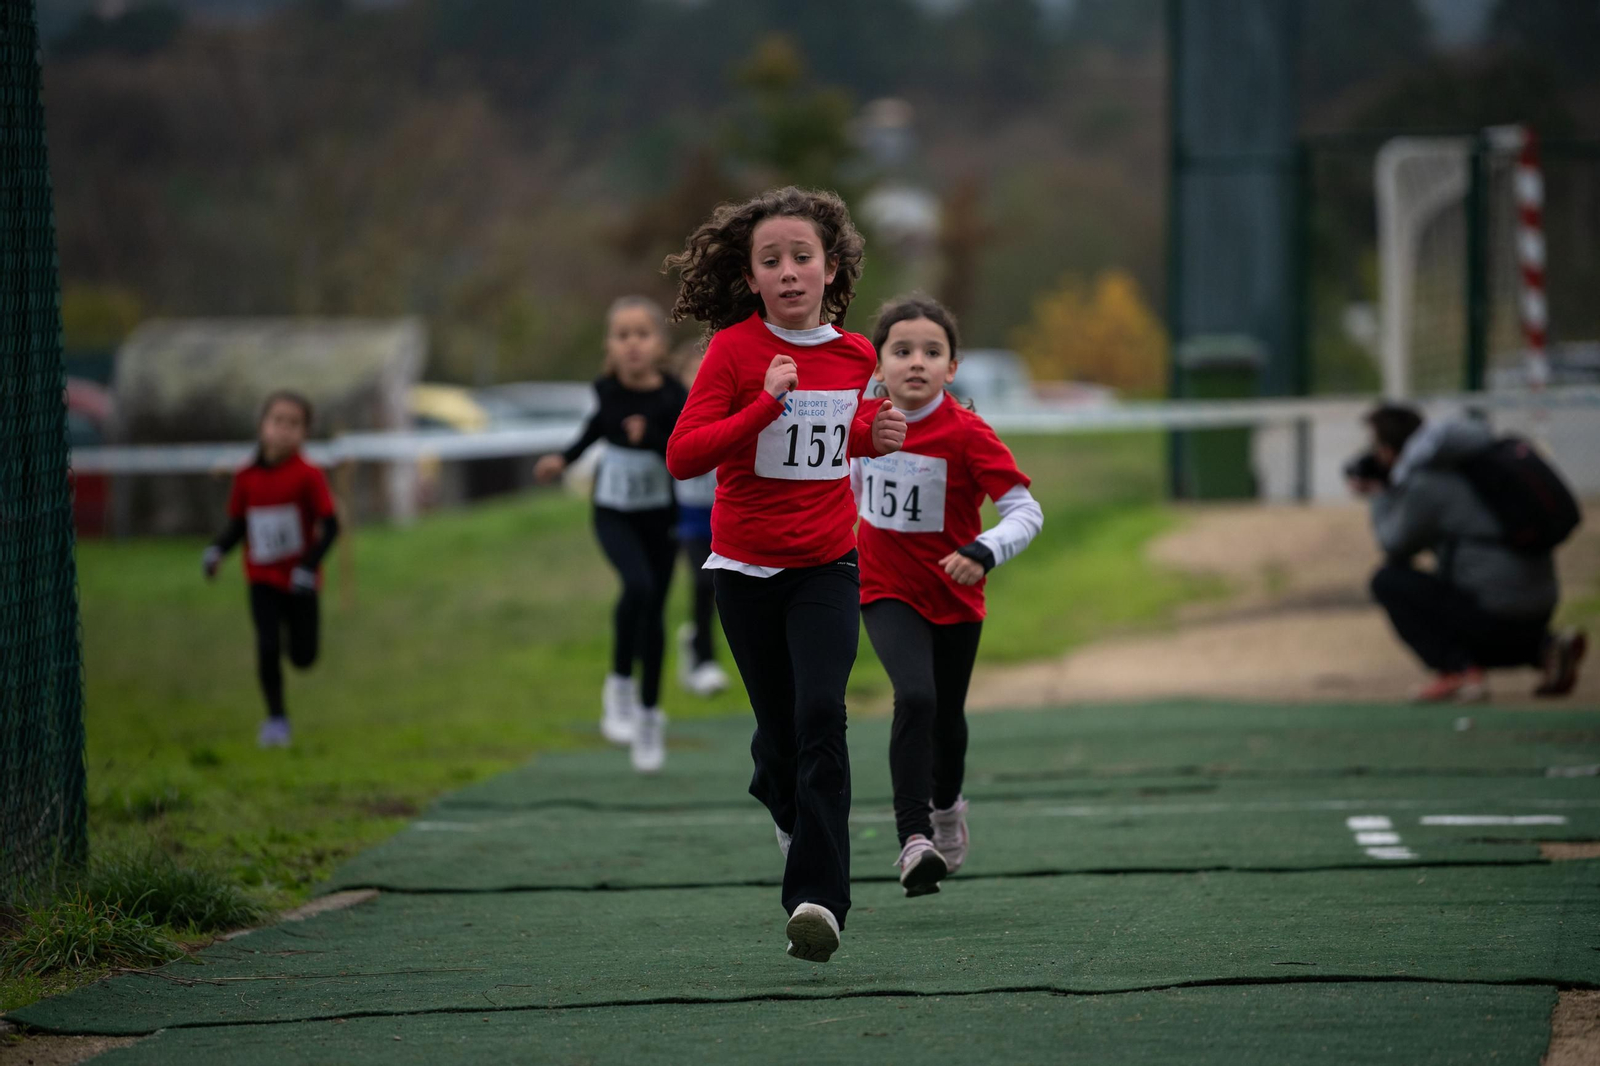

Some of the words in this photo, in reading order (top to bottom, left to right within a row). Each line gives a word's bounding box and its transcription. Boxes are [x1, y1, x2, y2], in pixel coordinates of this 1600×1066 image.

[798, 400, 828, 408] DEPORTE
[798, 409, 826, 417] GALEGO
[782, 424, 846, 467] 152
[866, 474, 922, 522] 154
